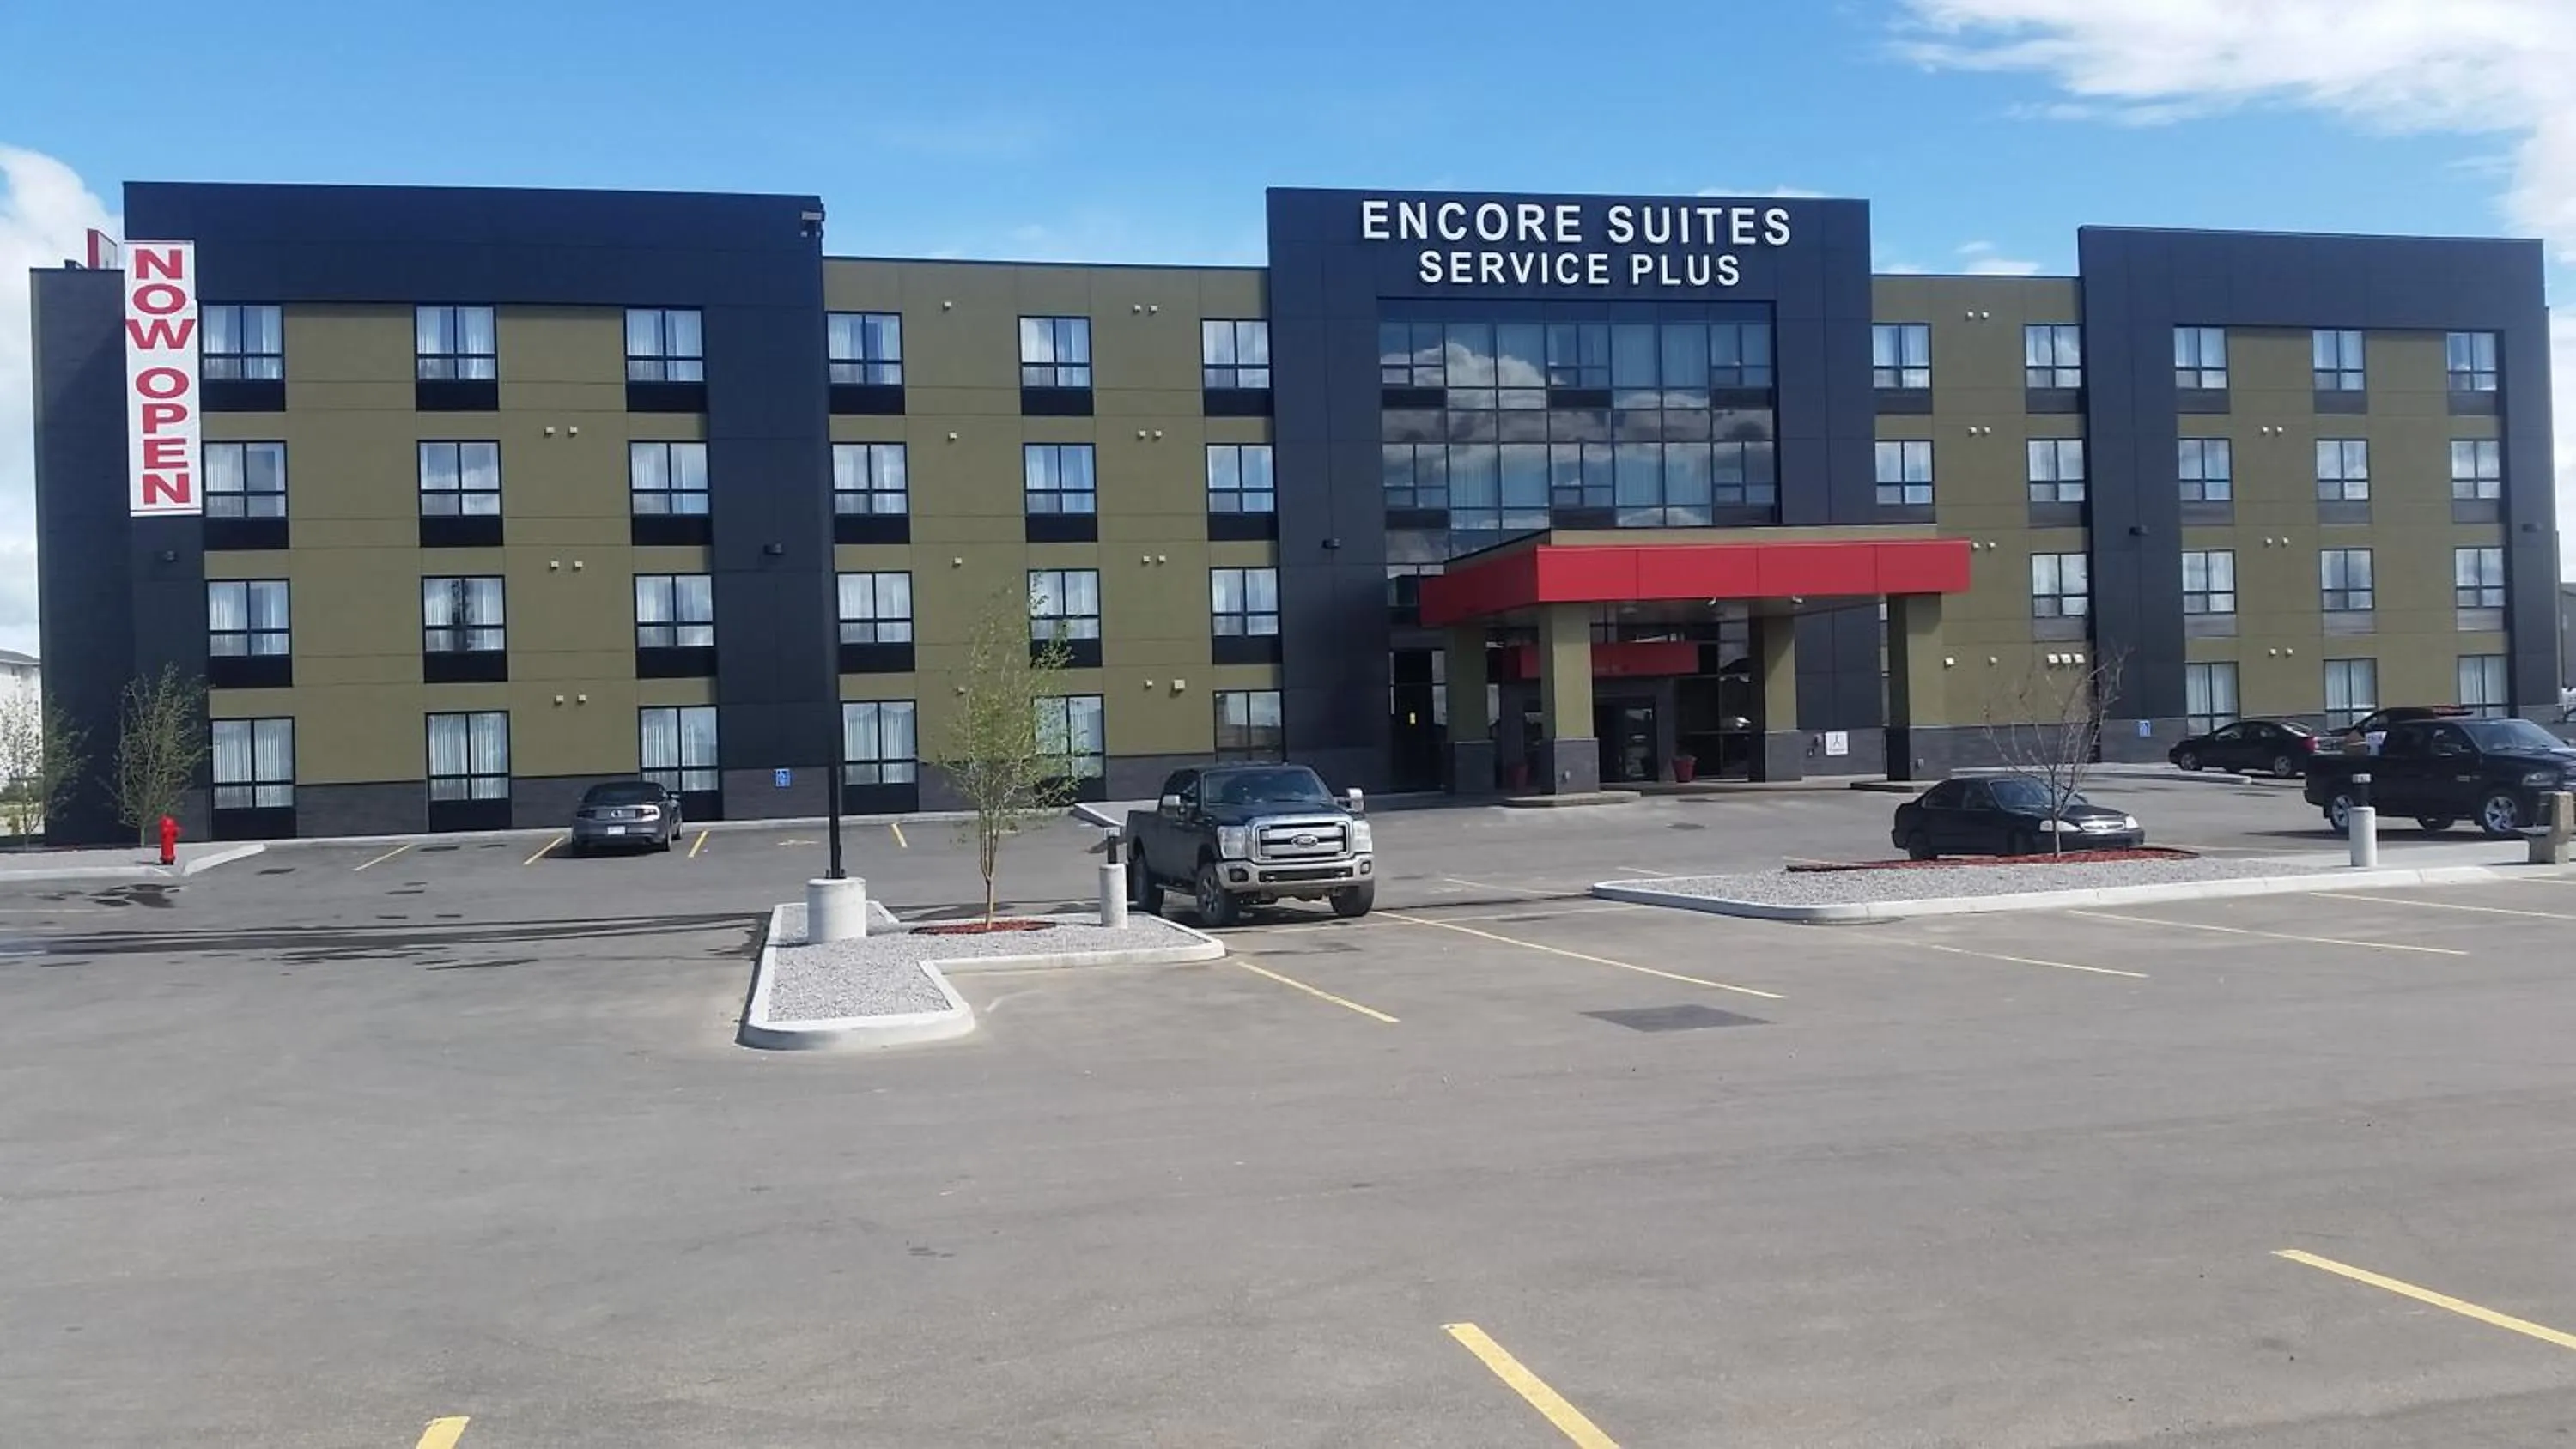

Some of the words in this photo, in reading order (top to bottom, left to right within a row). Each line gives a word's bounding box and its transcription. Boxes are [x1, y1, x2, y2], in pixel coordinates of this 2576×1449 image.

[1362, 200, 1583, 243] ENCORE
[1607, 205, 1791, 246] SUITES
[126, 248, 195, 350] NOW
[1419, 250, 1611, 284] SERVICE
[1631, 253, 1740, 286] PLUS
[135, 367, 190, 505] OPEN
